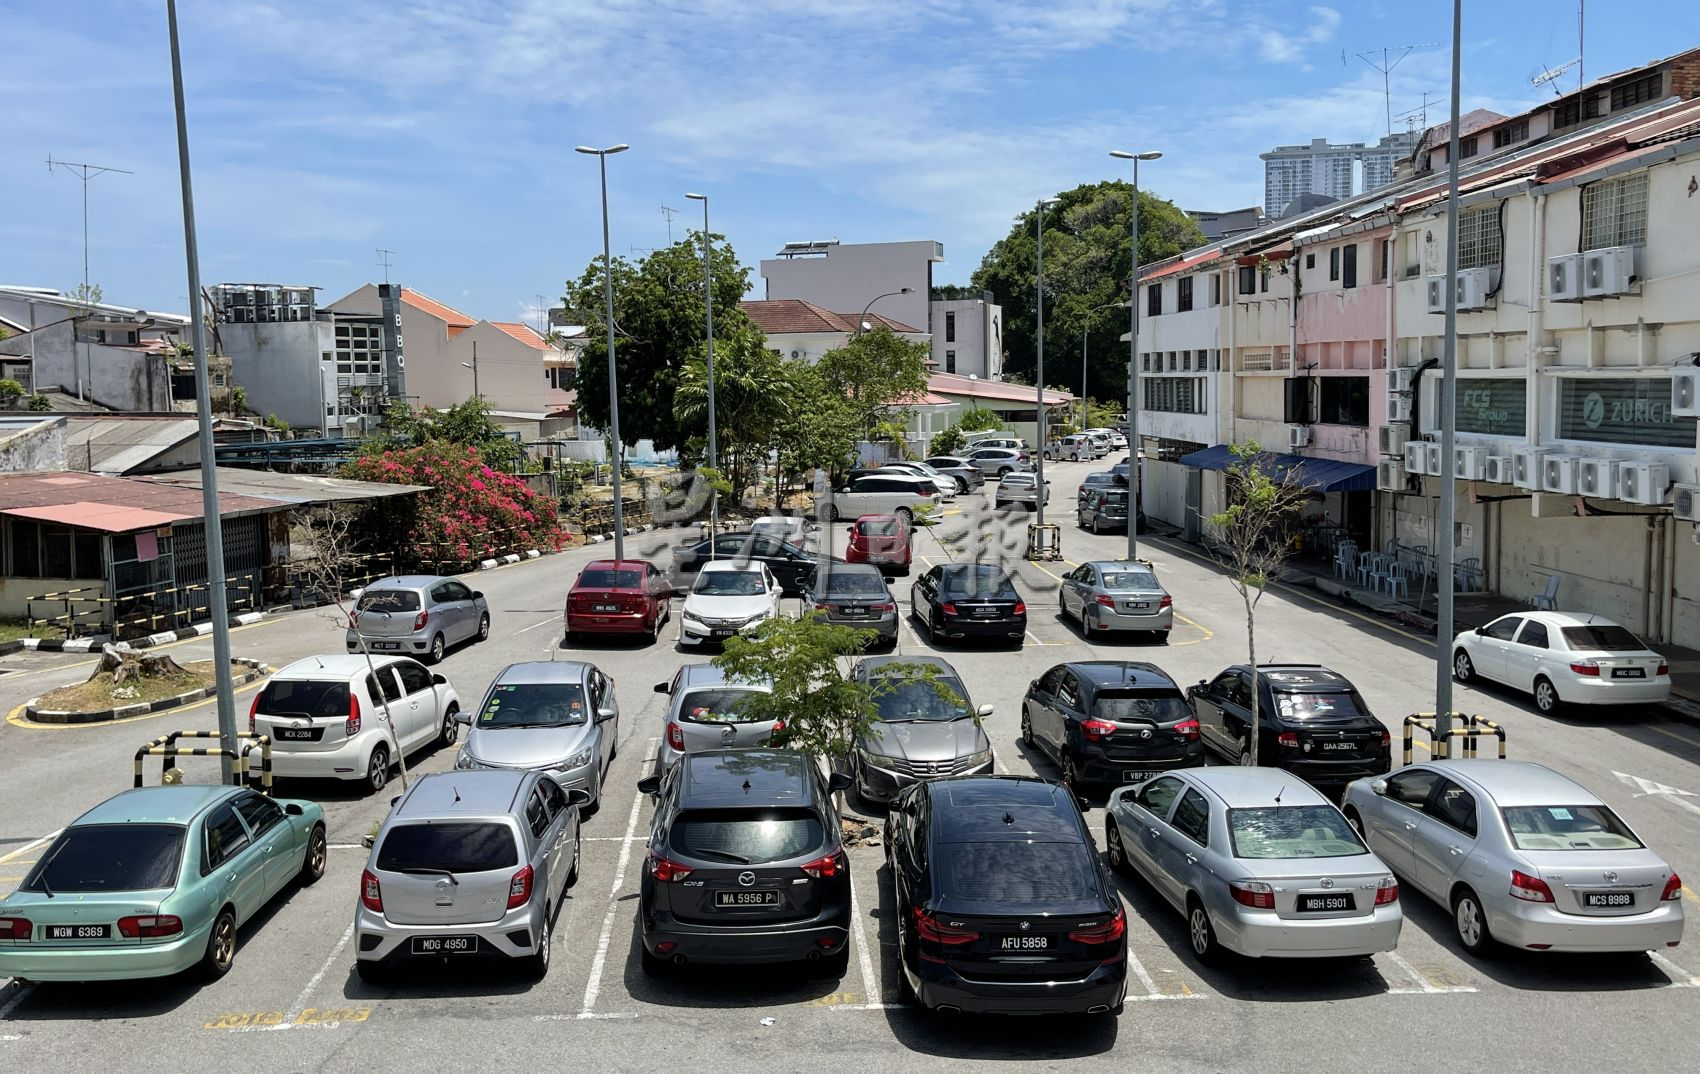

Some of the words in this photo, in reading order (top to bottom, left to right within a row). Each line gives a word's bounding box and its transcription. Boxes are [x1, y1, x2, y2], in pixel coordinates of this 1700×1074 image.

[1611, 401, 1674, 424] ZURICH
[1130, 772, 1143, 780] VBP
[722, 894, 735, 904] WA
[737, 893, 762, 903] 5956
[765, 893, 772, 903] P
[1306, 898, 1325, 909] MBH
[1326, 897, 1347, 908] 5901
[1589, 895, 1607, 905] MCS
[1608, 894, 1630, 905] 8988
[53, 927, 73, 937] WGW
[78, 926, 103, 937] 6369
[423, 939, 441, 950] MDG
[444, 938, 467, 949] 4950
[1001, 937, 1020, 949] AFU
[1022, 937, 1048, 949] 5858
